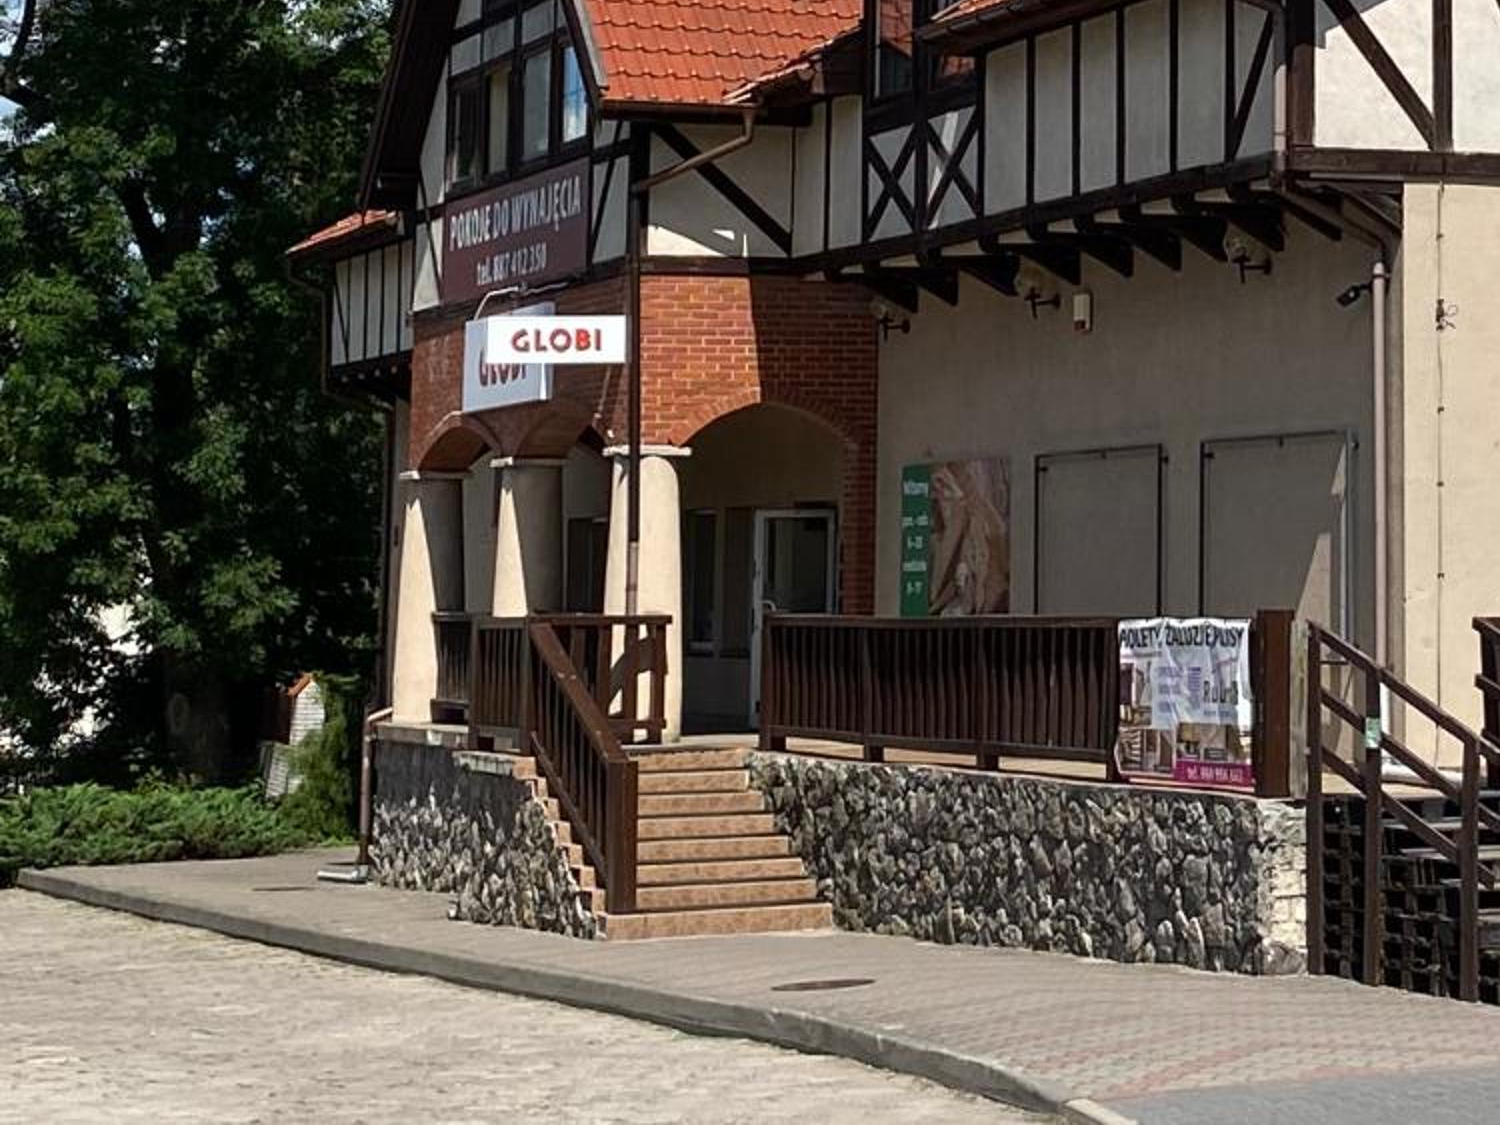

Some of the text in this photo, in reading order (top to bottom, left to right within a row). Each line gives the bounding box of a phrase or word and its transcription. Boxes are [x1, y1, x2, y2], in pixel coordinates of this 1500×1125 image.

[449, 175, 581, 252] POKOJE DO WYNAJĘCIA
[510, 328, 602, 353] GLOBI
